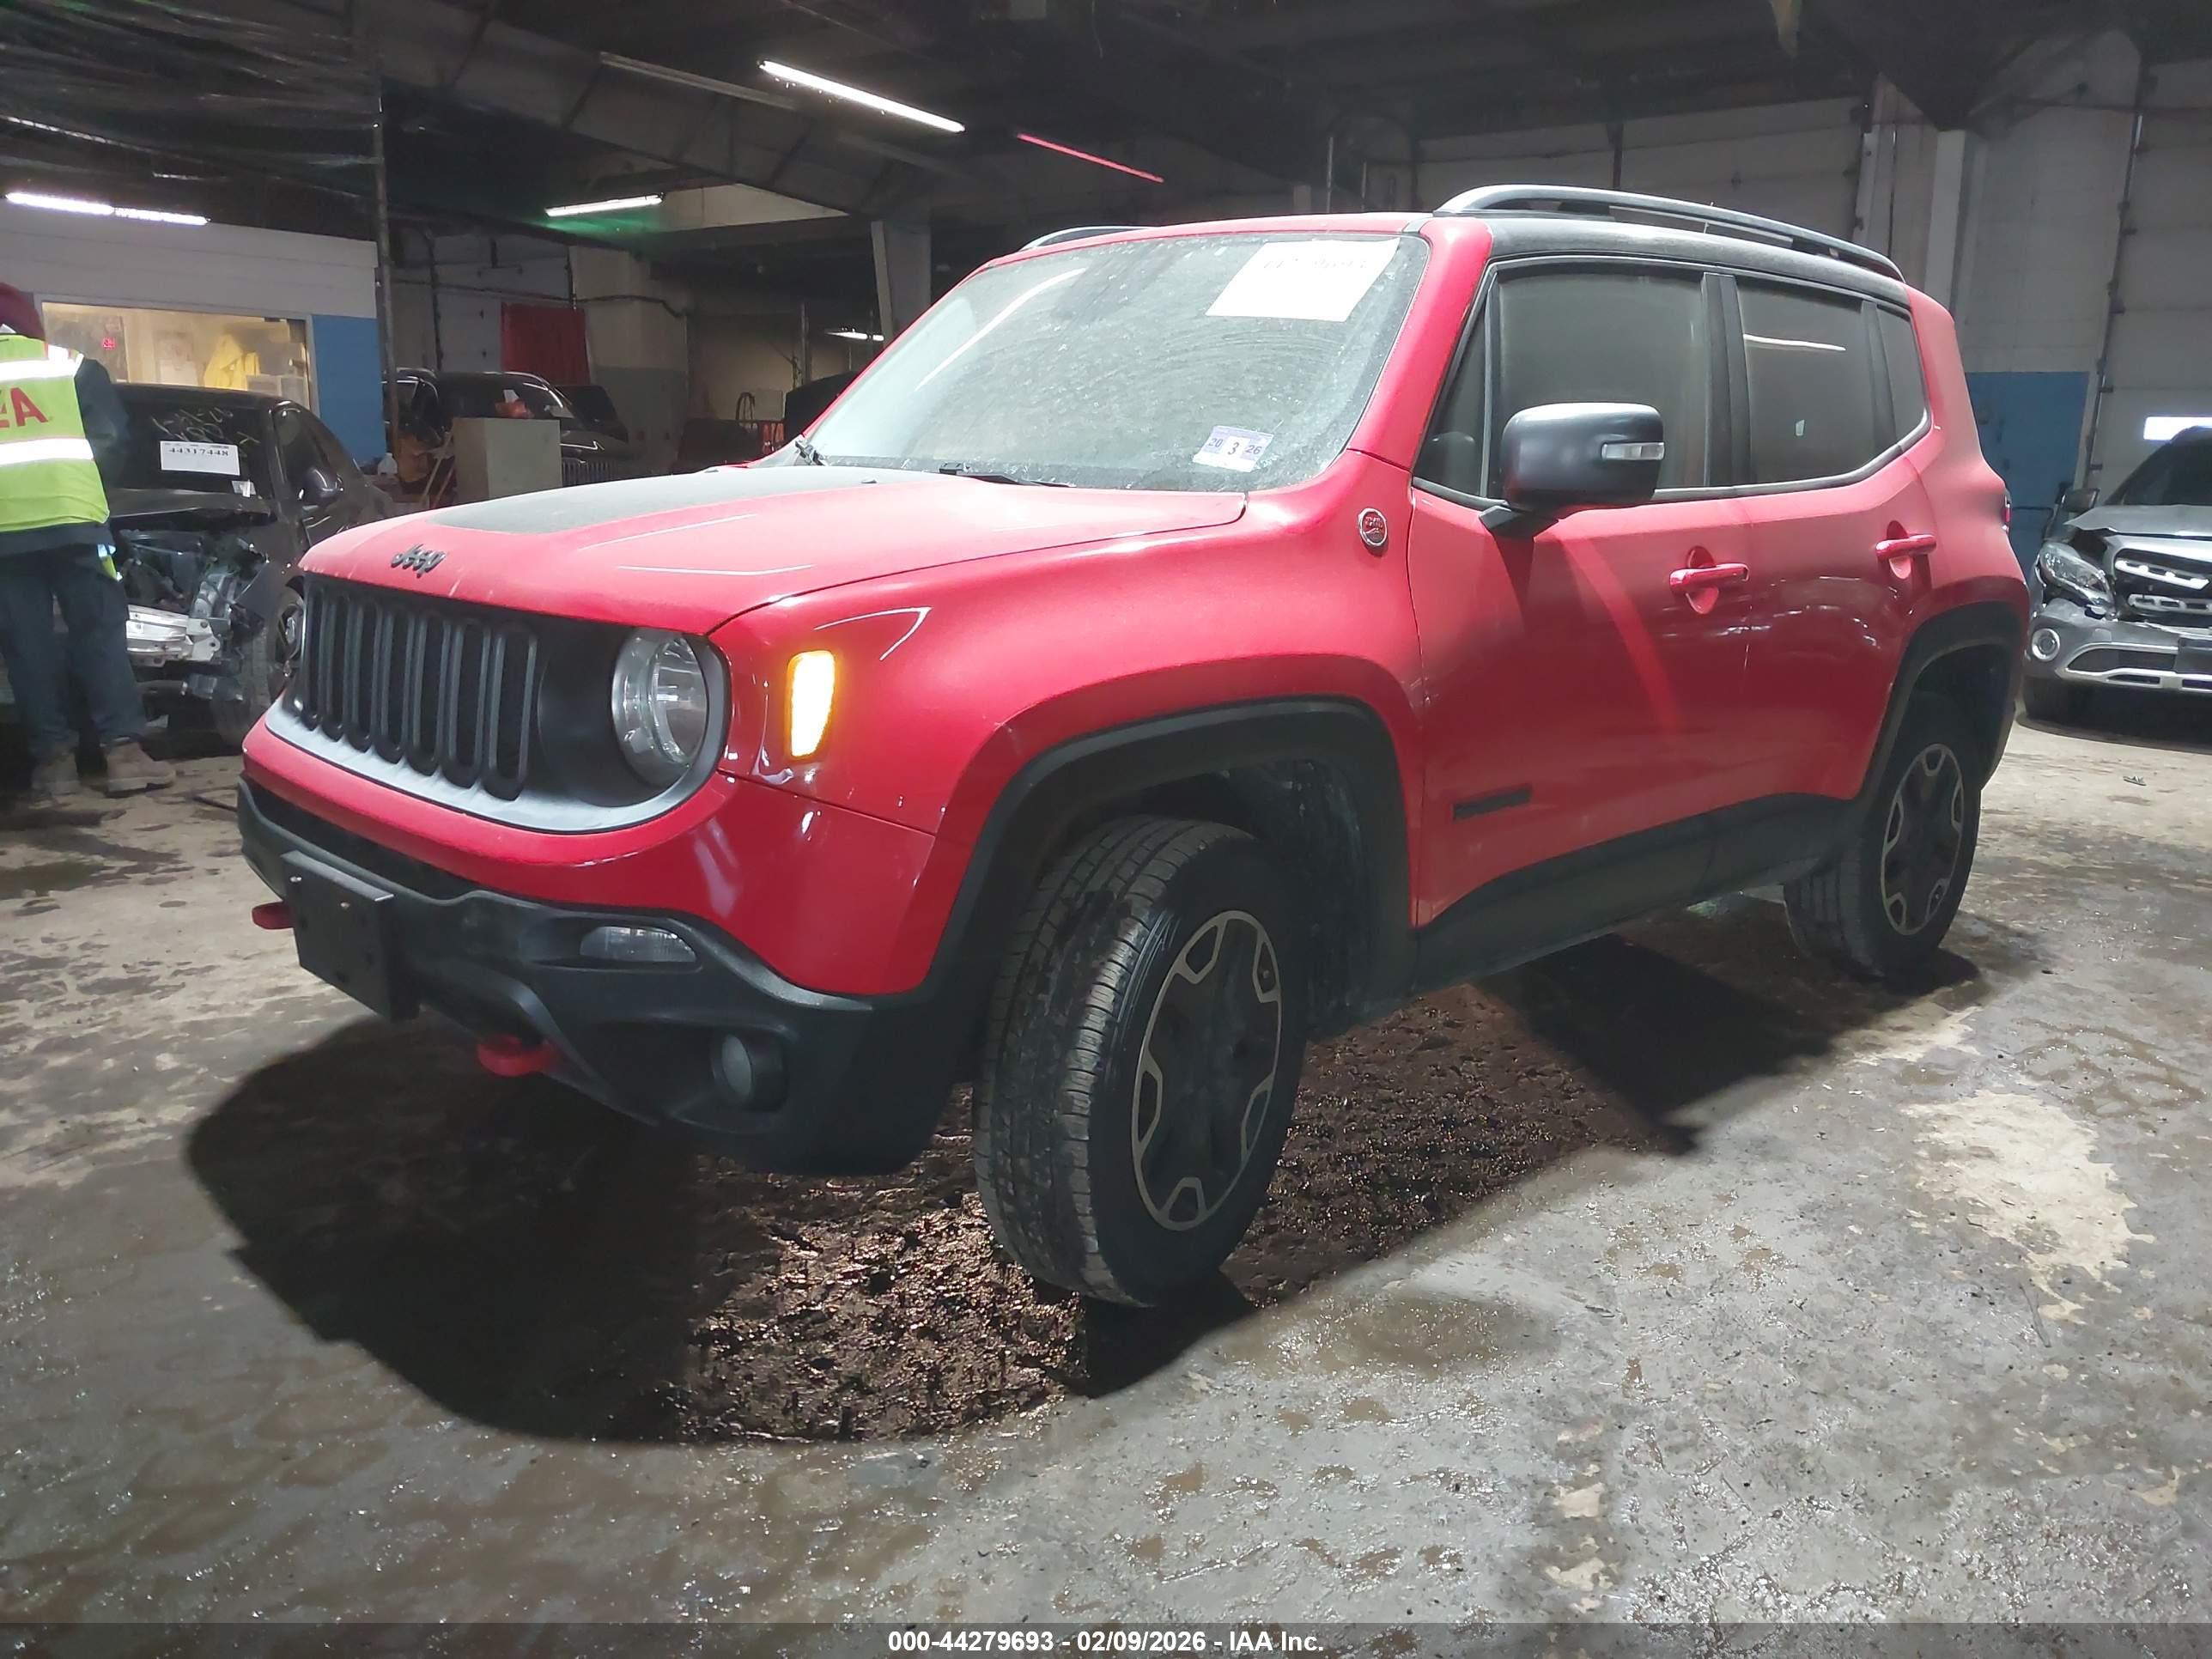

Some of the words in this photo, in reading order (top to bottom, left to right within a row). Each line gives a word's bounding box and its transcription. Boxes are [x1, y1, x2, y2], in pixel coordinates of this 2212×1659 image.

[1207, 438, 1224, 447] 20
[1227, 441, 1240, 455] 3
[1245, 445, 1262, 454] 26
[391, 544, 446, 578] Jeep
